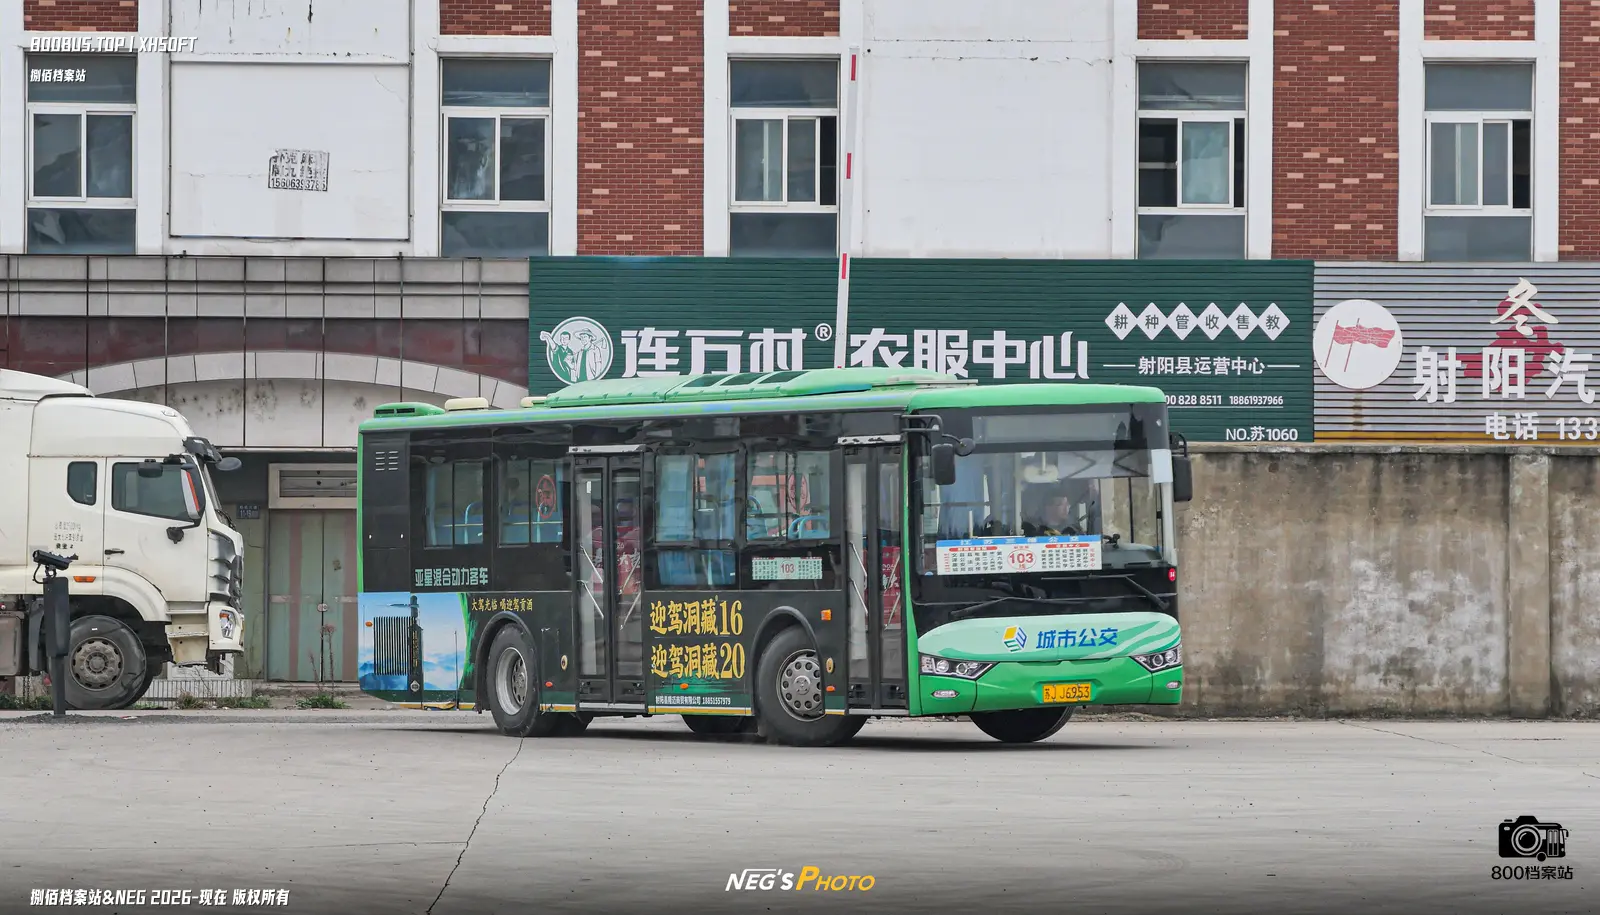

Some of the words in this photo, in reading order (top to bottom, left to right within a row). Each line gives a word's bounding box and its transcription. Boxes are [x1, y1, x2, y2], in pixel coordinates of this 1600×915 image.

[1113, 314, 1281, 330] 耕种管收售教
[1138, 356, 1266, 375] 射阳县运营中心
[1413, 345, 1596, 404] 射阳汽
[1178, 394, 1198, 405] 828
[1199, 394, 1222, 405] 8511
[1229, 395, 1284, 406] 18861937966
[1225, 426, 1298, 442] NO.苏1060
[1485, 411, 1540, 441] 电话
[1555, 416, 1598, 441] 133
[1009, 553, 1033, 564] 103
[414, 567, 489, 587] 亚星混合动力客车
[780, 563, 795, 574] 103
[649, 599, 743, 636] 迎驾洞藏16
[1035, 627, 1119, 650] 城市公交
[650, 642, 745, 680] 迎驾洞藏20
